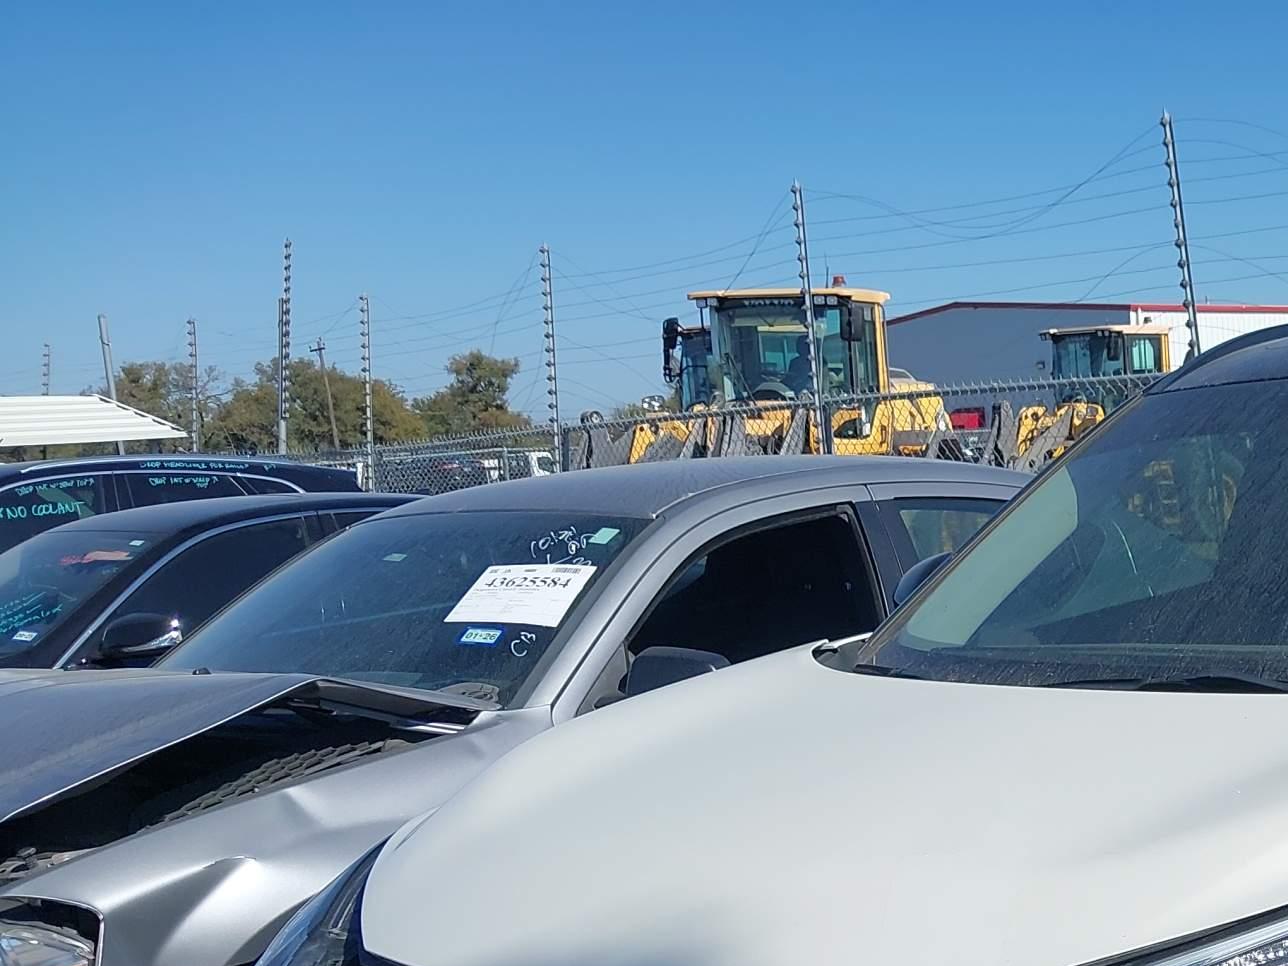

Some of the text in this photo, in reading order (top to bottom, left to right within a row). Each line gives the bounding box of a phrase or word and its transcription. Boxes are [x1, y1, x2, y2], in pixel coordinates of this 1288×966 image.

[6, 500, 86, 520] NO COOLANT
[484, 575, 573, 589] 43625584
